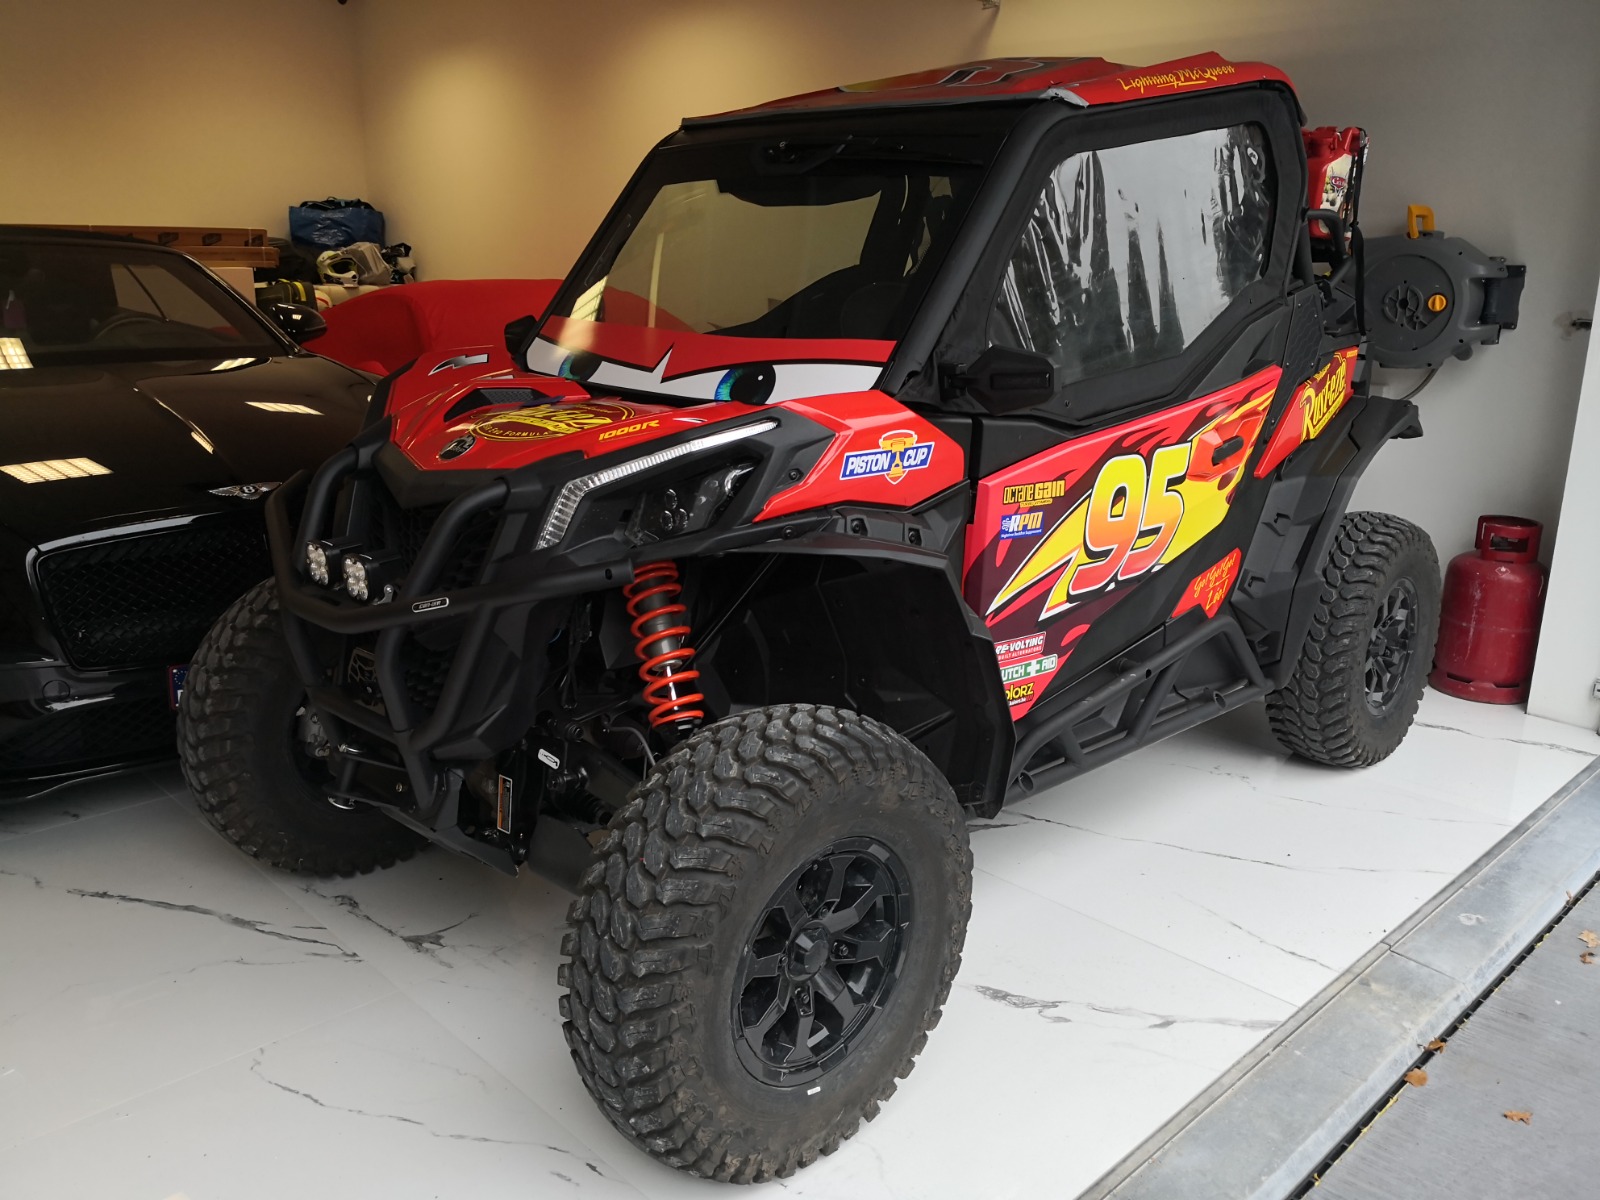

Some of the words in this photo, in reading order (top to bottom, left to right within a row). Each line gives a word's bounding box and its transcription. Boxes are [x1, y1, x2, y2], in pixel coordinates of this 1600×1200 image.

[1116, 73, 1178, 94] Lightning
[1174, 65, 1235, 82] McQueen
[598, 420, 660, 441] 1000R
[846, 453, 892, 475] PISTON
[903, 447, 928, 467] CUP
[1008, 512, 1044, 532] RPM
[1067, 441, 1193, 596] 95
[1041, 656, 1057, 671] AID
